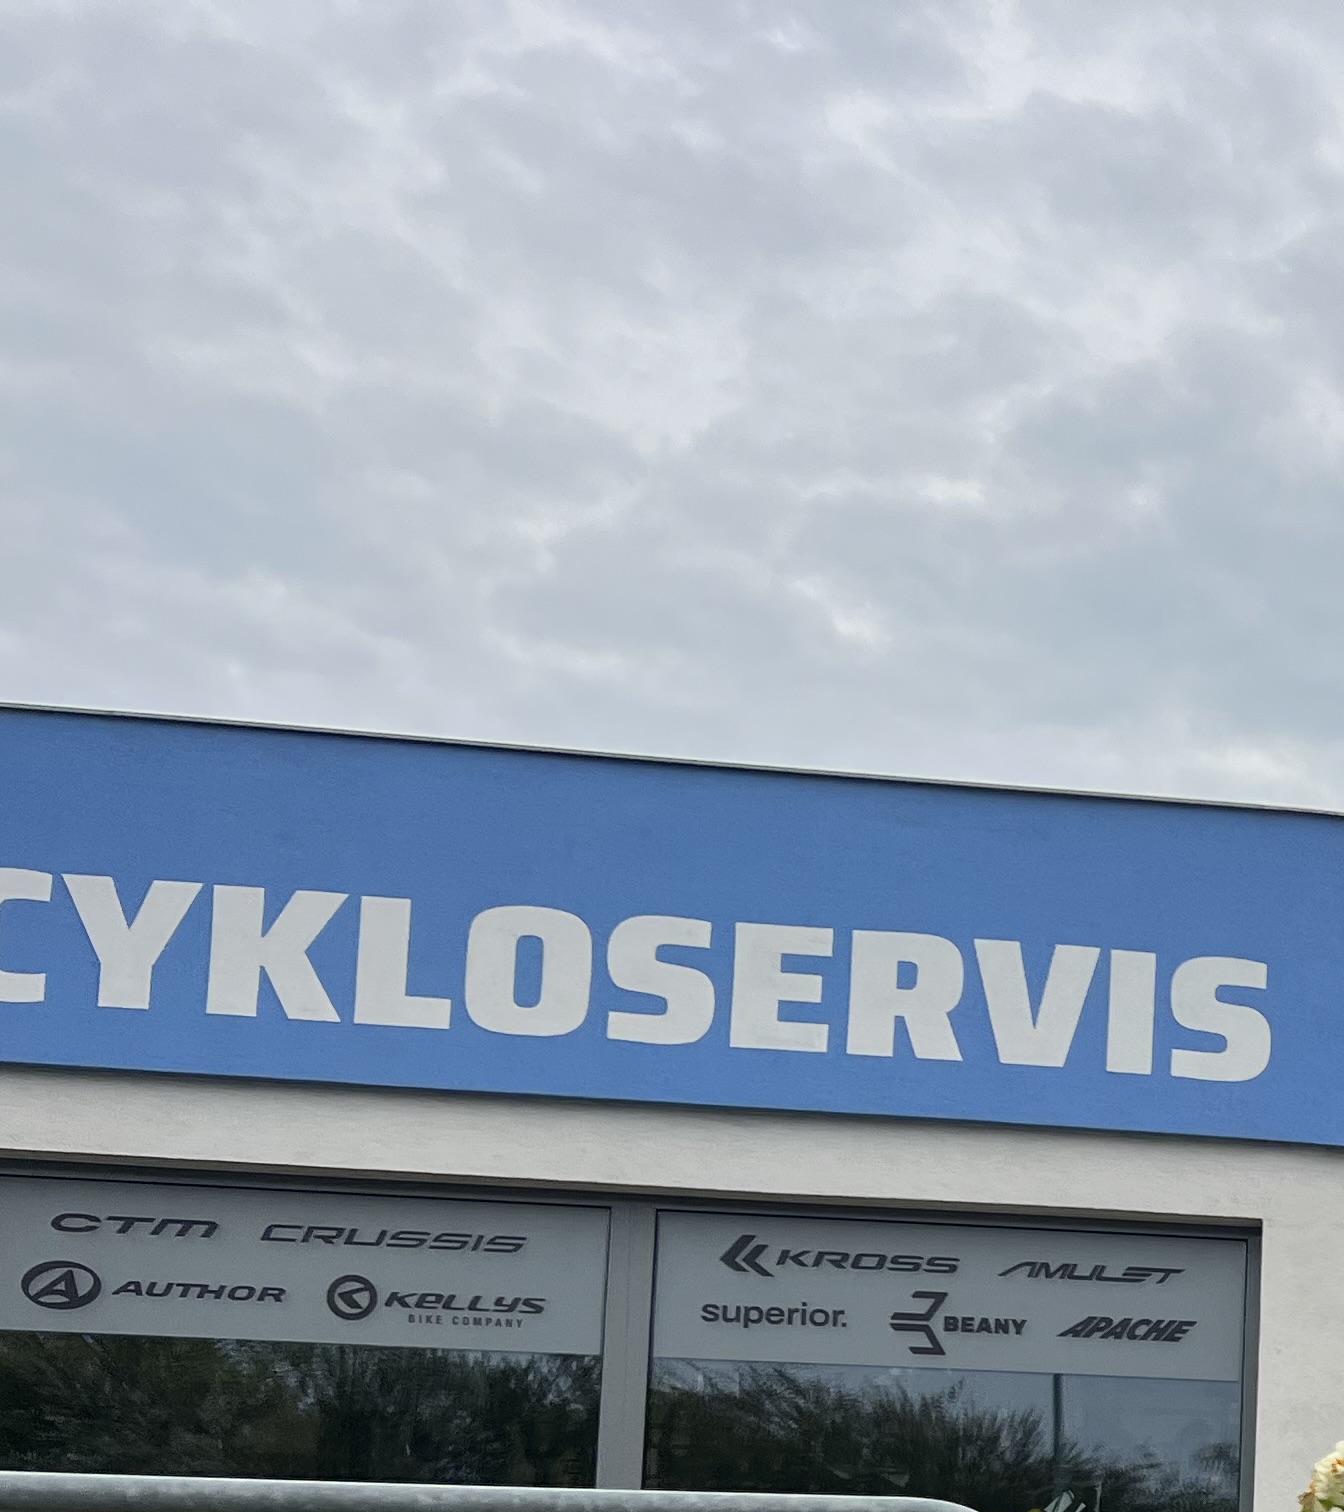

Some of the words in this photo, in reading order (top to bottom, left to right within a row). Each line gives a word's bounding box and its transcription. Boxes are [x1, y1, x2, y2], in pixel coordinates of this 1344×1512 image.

[260, 1224, 527, 1253] CRUSSIS
[776, 1249, 960, 1274] KROSS
[997, 1261, 1185, 1284] AMULET
[111, 1280, 286, 1303] AUTHOR
[408, 1313, 443, 1325] BIKE
[452, 1315, 524, 1329] COMPANY
[701, 1301, 848, 1329] superior.
[943, 1315, 1027, 1336] BEANY
[1057, 1316, 1198, 1343] APACHE
